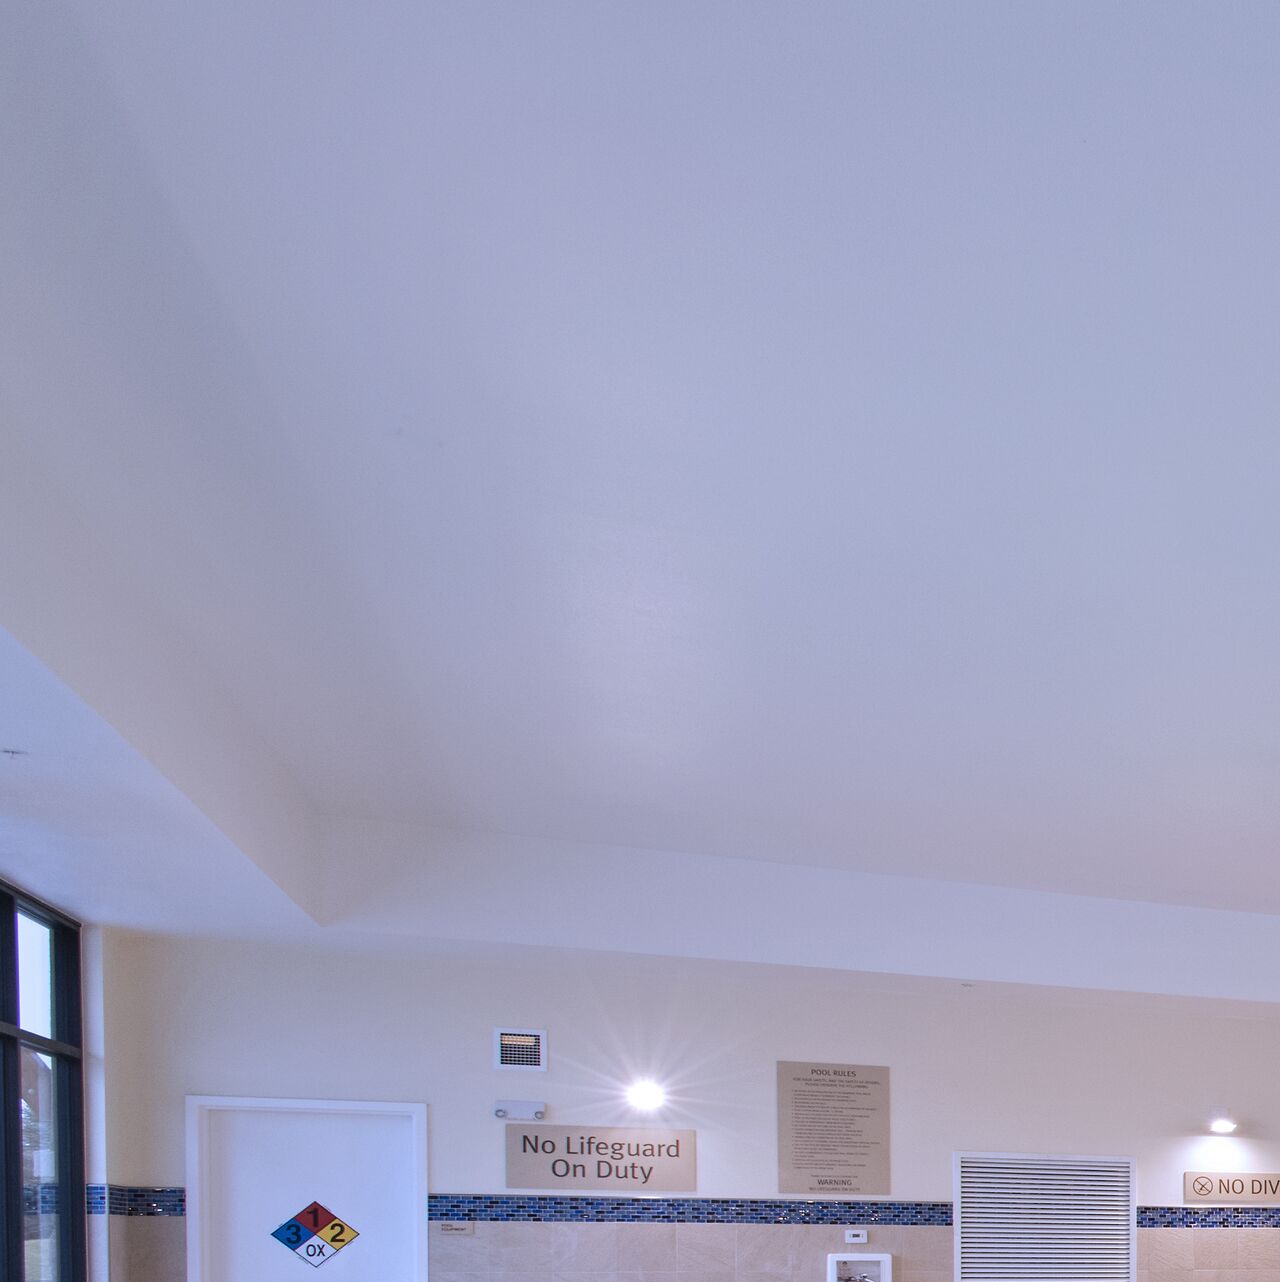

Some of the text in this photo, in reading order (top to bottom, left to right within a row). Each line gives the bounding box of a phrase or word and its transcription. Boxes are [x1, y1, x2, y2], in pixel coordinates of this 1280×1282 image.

[811, 1068, 857, 1078] POOL RULES
[522, 1135, 680, 1160] No Lifeguard
[552, 1159, 654, 1184] On Duty
[817, 1178, 853, 1187] WARNING
[1218, 1179, 1244, 1195] NO
[306, 1207, 319, 1228] 1
[286, 1223, 302, 1245] 3
[330, 1223, 346, 1243] 2
[306, 1244, 326, 1257] OX
